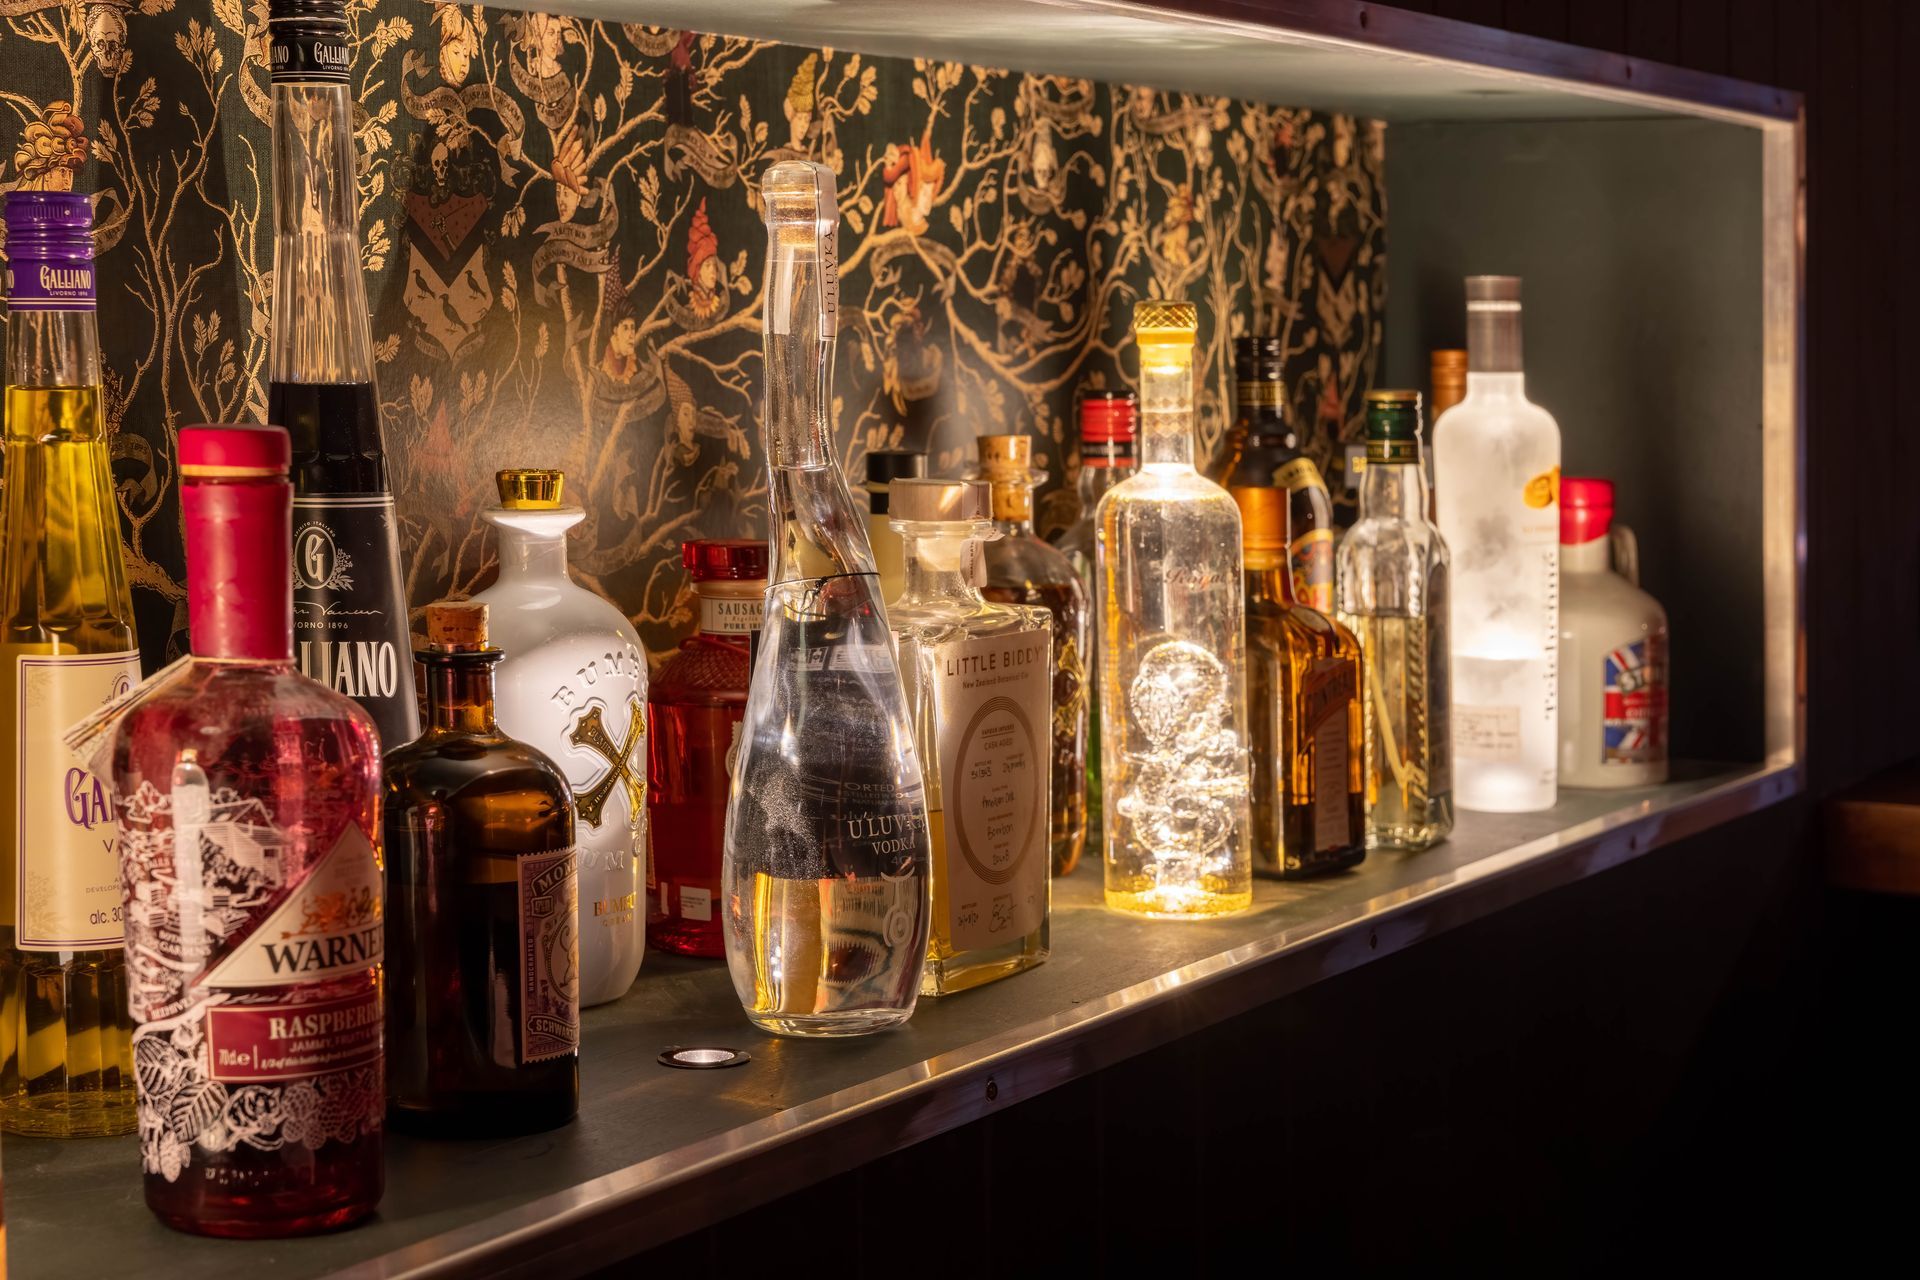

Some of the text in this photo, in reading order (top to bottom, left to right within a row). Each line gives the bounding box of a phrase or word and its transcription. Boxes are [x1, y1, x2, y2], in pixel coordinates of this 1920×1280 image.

[40, 265, 92, 290] GALLIANO
[312, 520, 336, 538] ITALIANO
[305, 534, 325, 583] G
[718, 603, 763, 615] SAUSAG
[293, 621, 349, 629] ORNO 1896
[300, 641, 398, 698] LIANO
[947, 647, 1041, 676] LITTLE BIDDY
[872, 837, 916, 855] VODKA
[90, 907, 110, 925] alc.
[268, 1002, 384, 1040] RASPBERR
[536, 1019, 579, 1041] SCHWARZ
